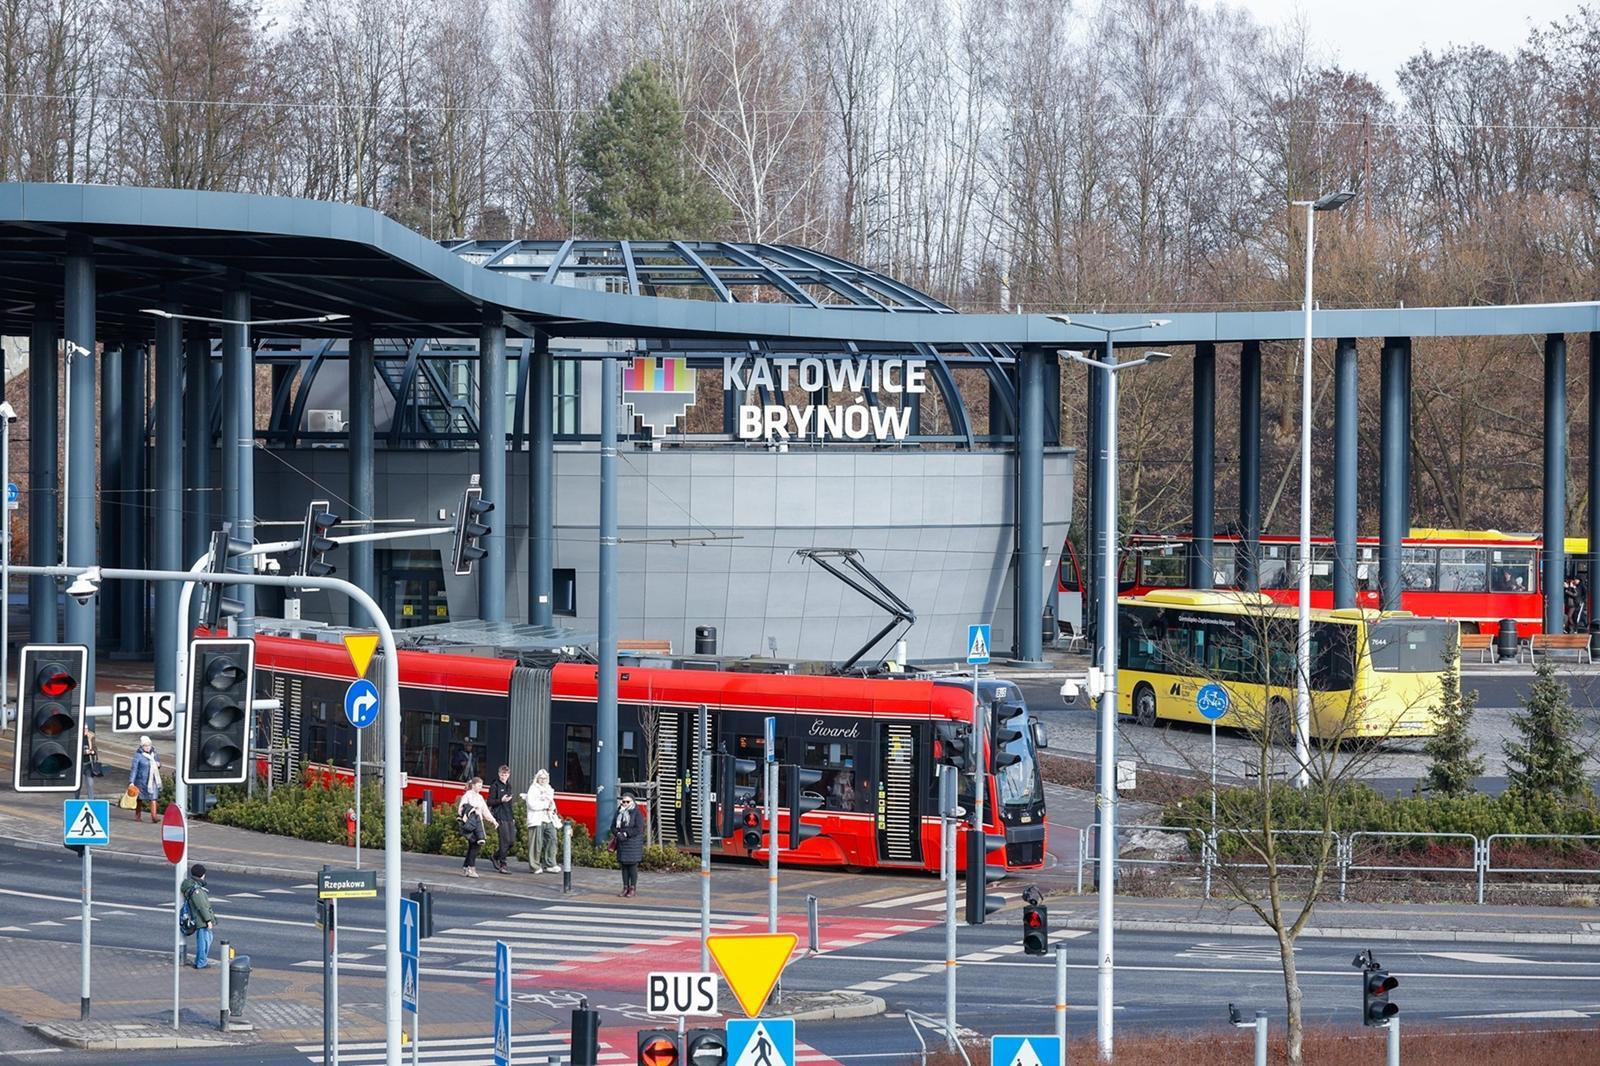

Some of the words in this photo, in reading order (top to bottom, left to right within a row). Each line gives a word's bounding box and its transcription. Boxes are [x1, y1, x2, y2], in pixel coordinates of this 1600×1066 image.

[723, 357, 926, 393] KATOWICE
[739, 396, 912, 440] BRYNÓW
[116, 695, 172, 730] BUS
[808, 718, 860, 738] Gwarek
[324, 880, 366, 890] Rzepakowa
[651, 976, 713, 1012] BUS
